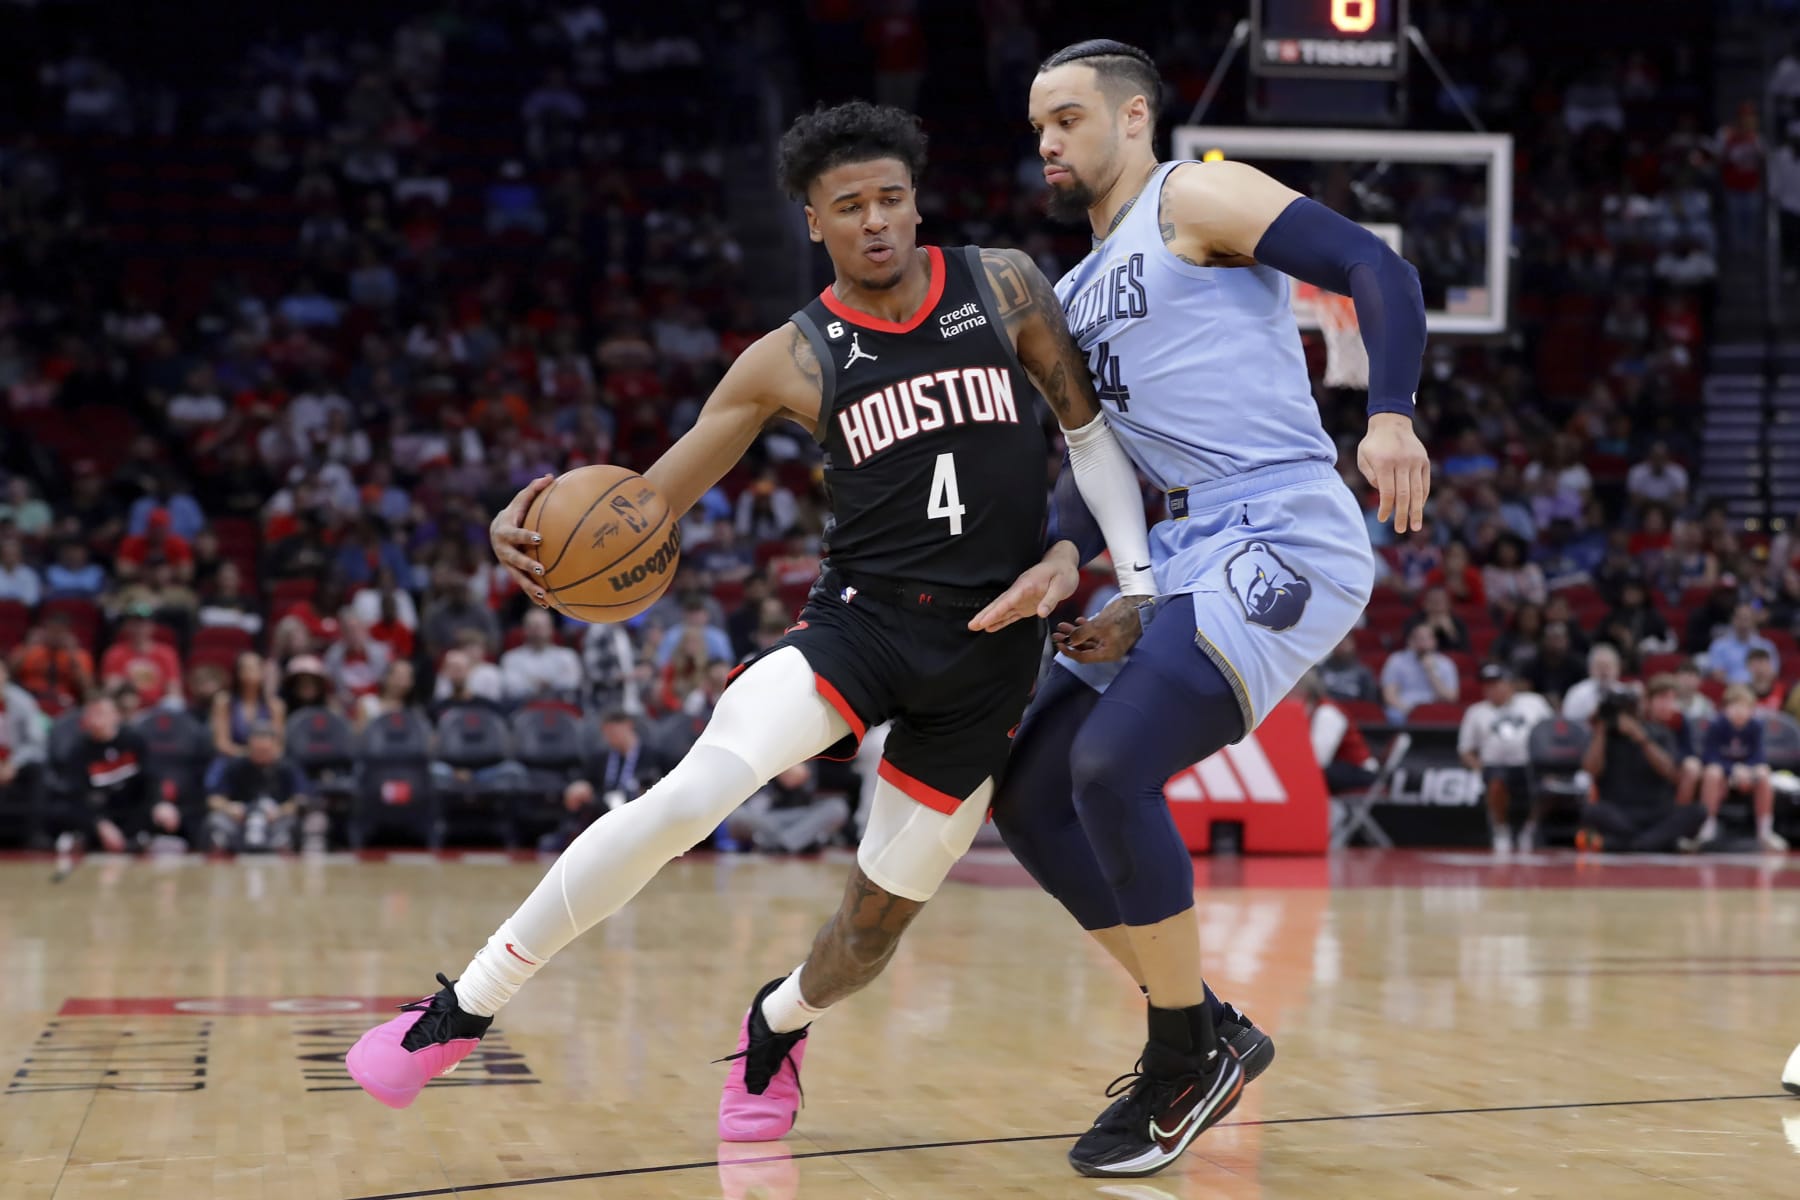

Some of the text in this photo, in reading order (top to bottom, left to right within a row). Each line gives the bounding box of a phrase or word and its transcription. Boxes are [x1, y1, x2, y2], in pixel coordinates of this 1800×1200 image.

[939, 302, 980, 325] credit
[826, 321, 844, 339] 6
[940, 315, 987, 339] karma
[838, 366, 1020, 467] HOUSTON
[927, 452, 966, 536] 4
